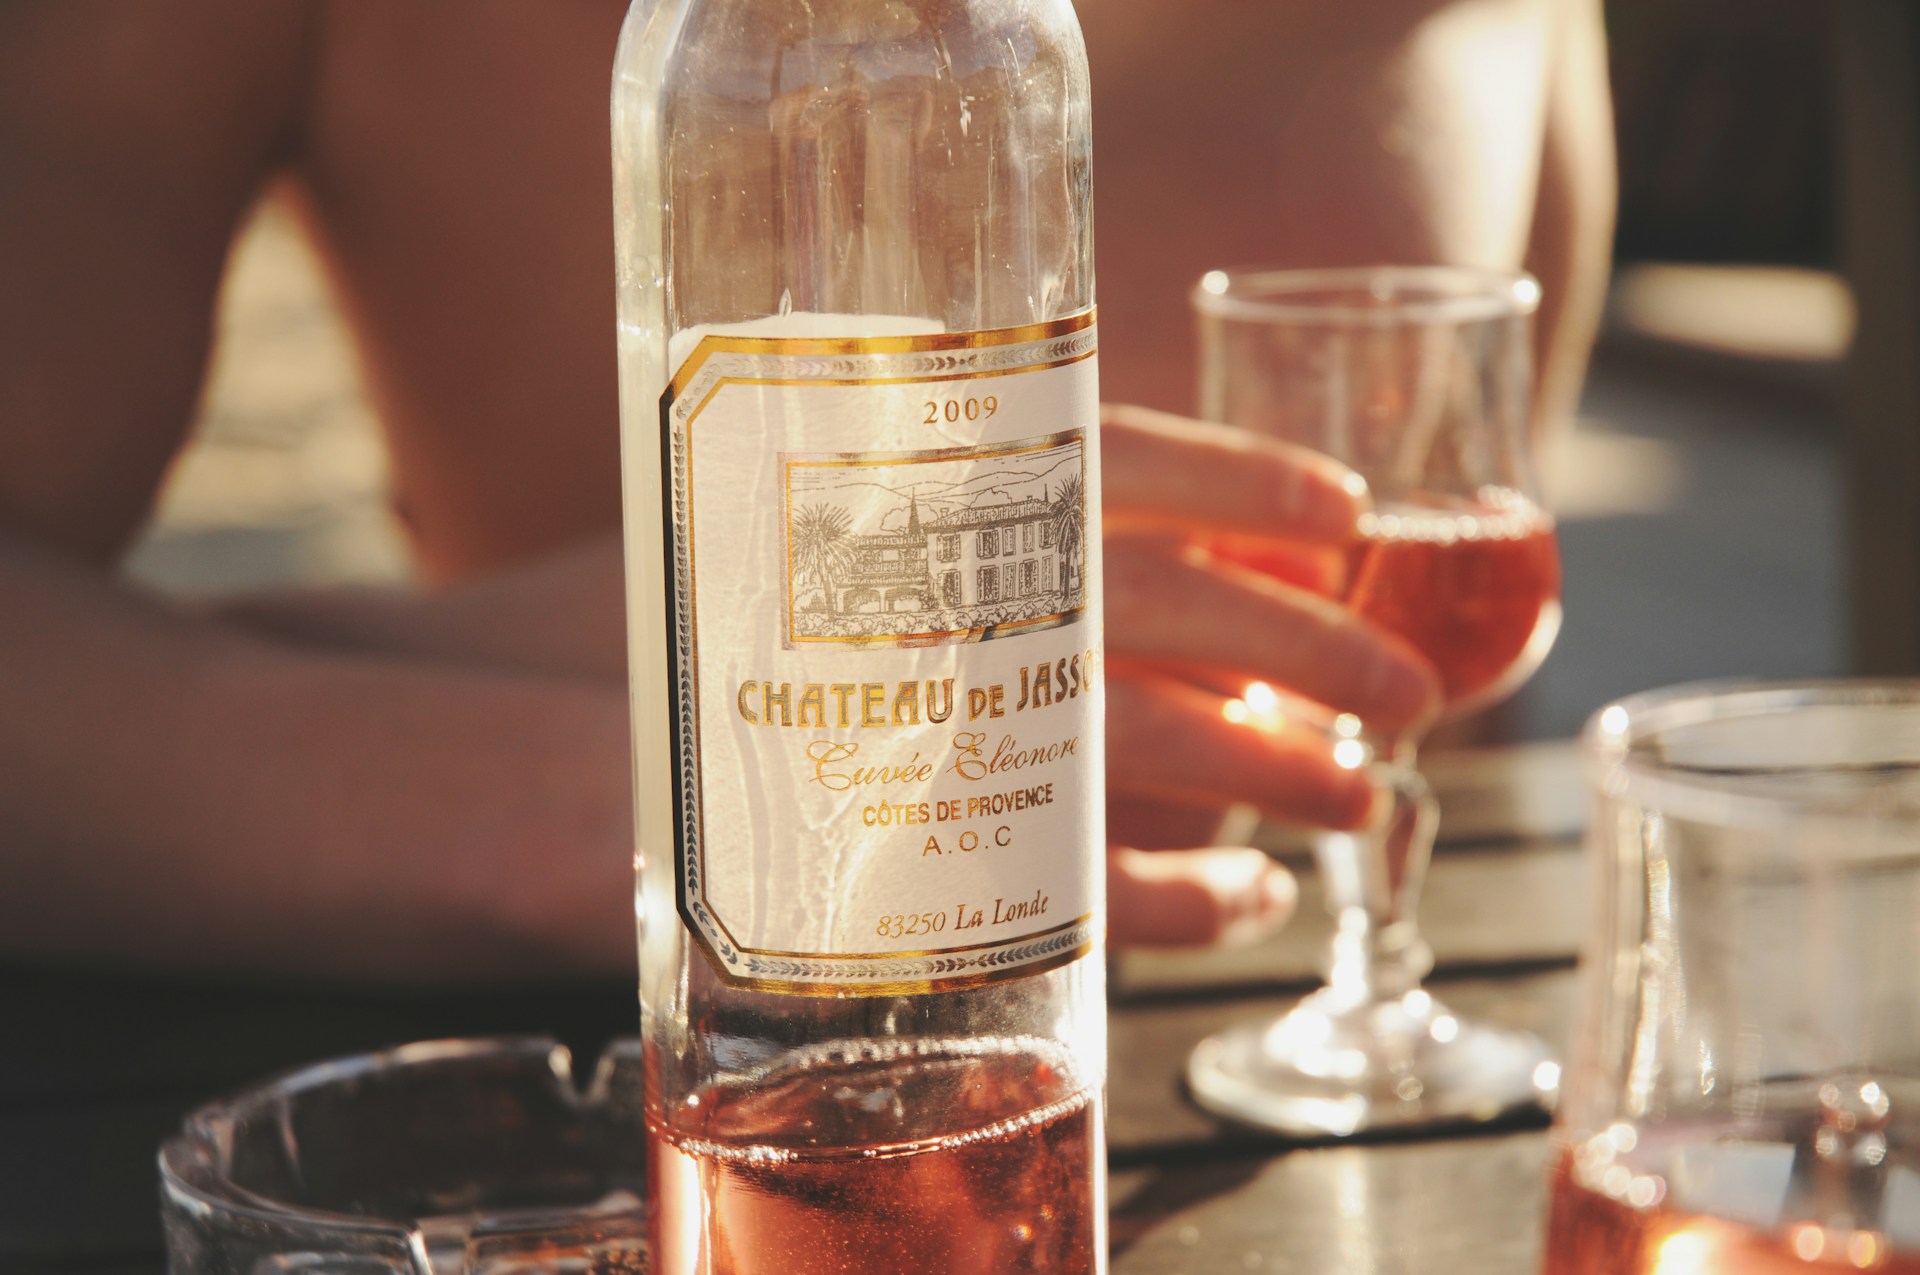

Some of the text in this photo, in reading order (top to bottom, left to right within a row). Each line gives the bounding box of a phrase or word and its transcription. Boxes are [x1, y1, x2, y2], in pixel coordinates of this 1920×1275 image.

[923, 396, 998, 424] 2009
[737, 648, 1096, 728] CHATEAU DE JASSO
[807, 731, 1080, 791] Cuvée Eléonore
[862, 783, 1054, 827] CÔTES DE PROVENCE
[876, 889, 1049, 939] 83250 La Londe
